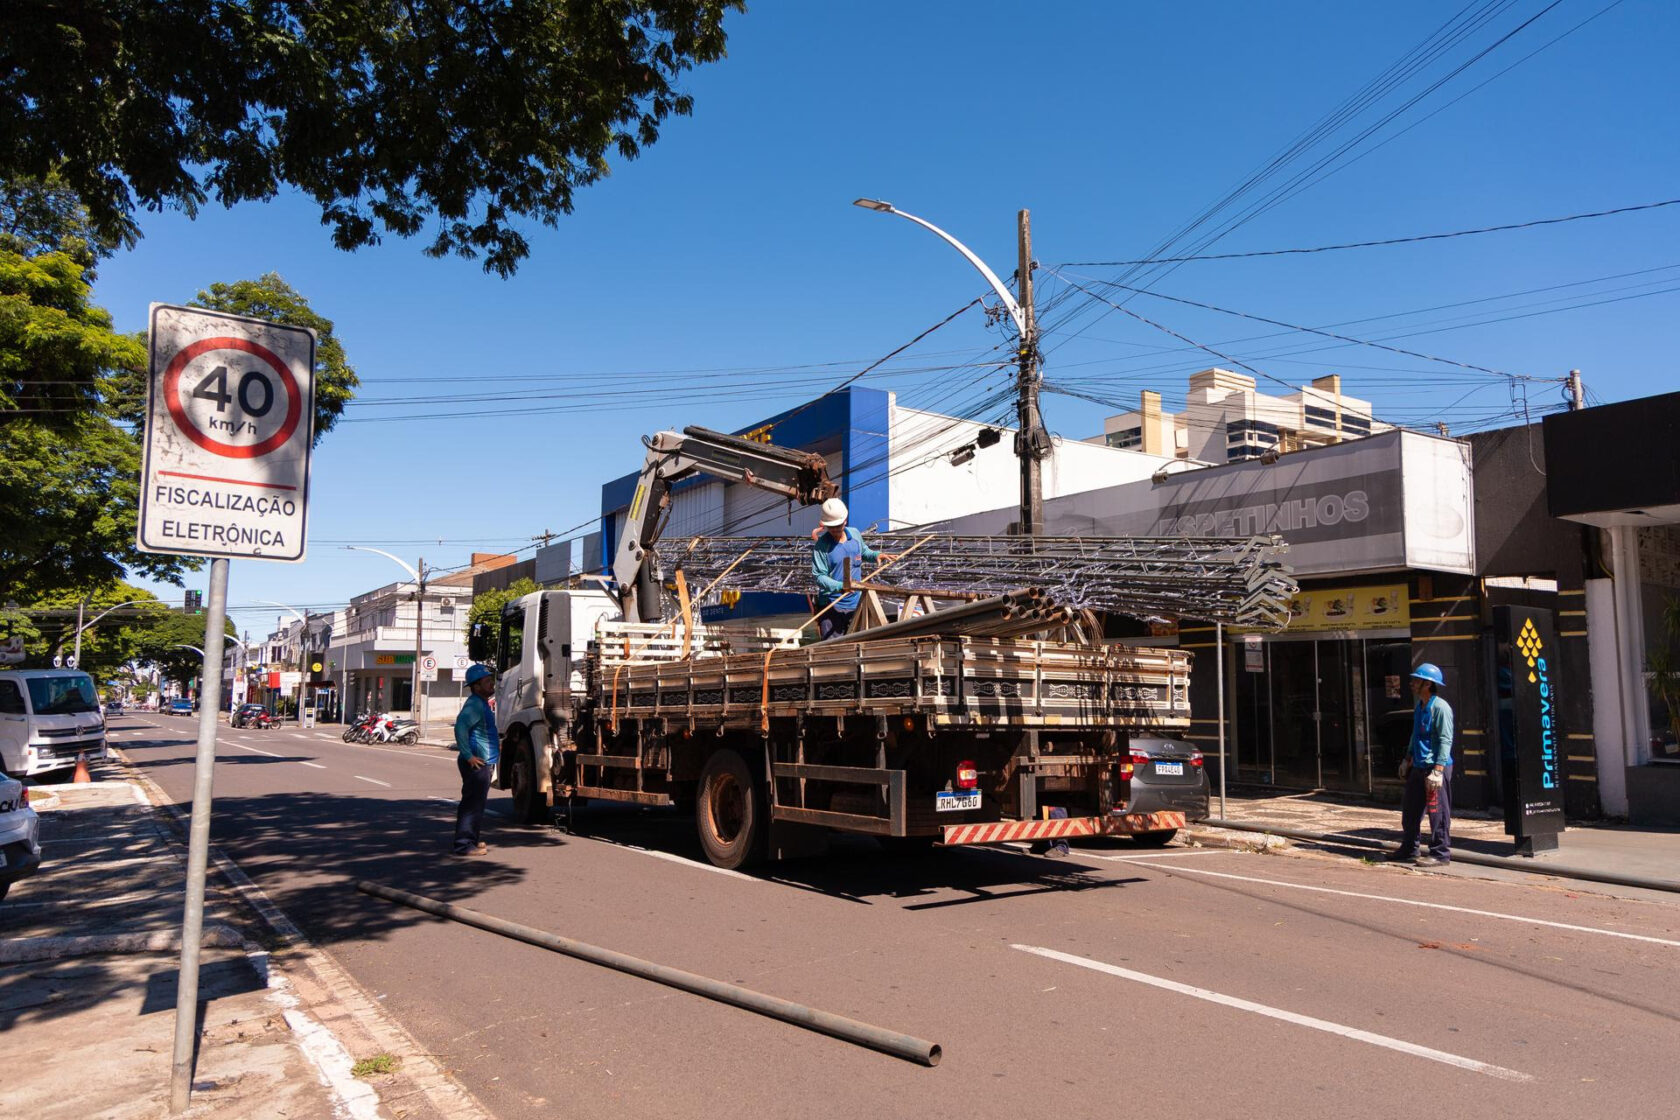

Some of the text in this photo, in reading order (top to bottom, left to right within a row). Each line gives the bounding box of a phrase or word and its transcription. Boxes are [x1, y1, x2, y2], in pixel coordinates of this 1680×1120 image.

[193, 366, 274, 418] 40
[209, 416, 257, 436] km/h
[155, 485, 296, 518] FISCALIZAÇÃO
[161, 519, 286, 547] ELETRÔNICA
[1538, 657, 1554, 789] Primavera
